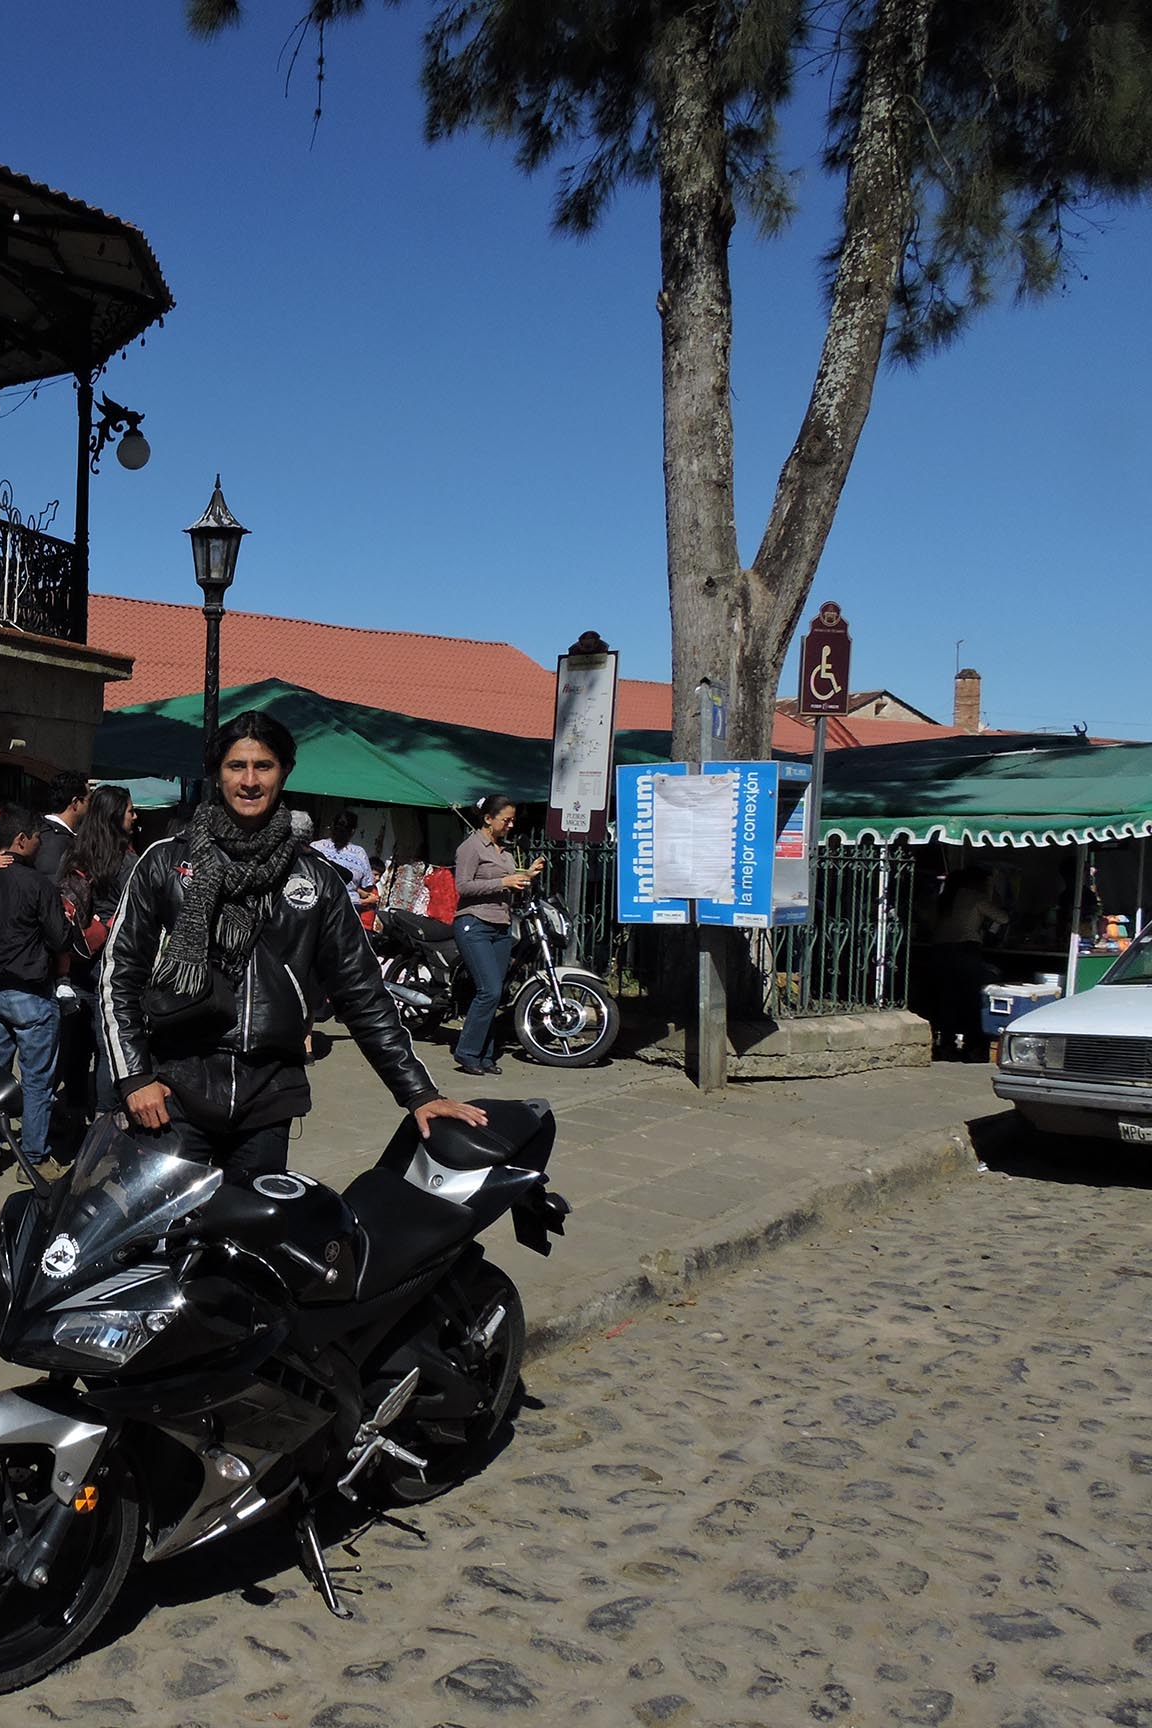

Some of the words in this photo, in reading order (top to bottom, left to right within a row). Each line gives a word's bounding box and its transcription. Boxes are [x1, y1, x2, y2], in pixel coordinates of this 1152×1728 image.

[741, 771, 759, 841] conexión
[739, 845, 758, 890] mejor
[738, 896, 753, 906] la
